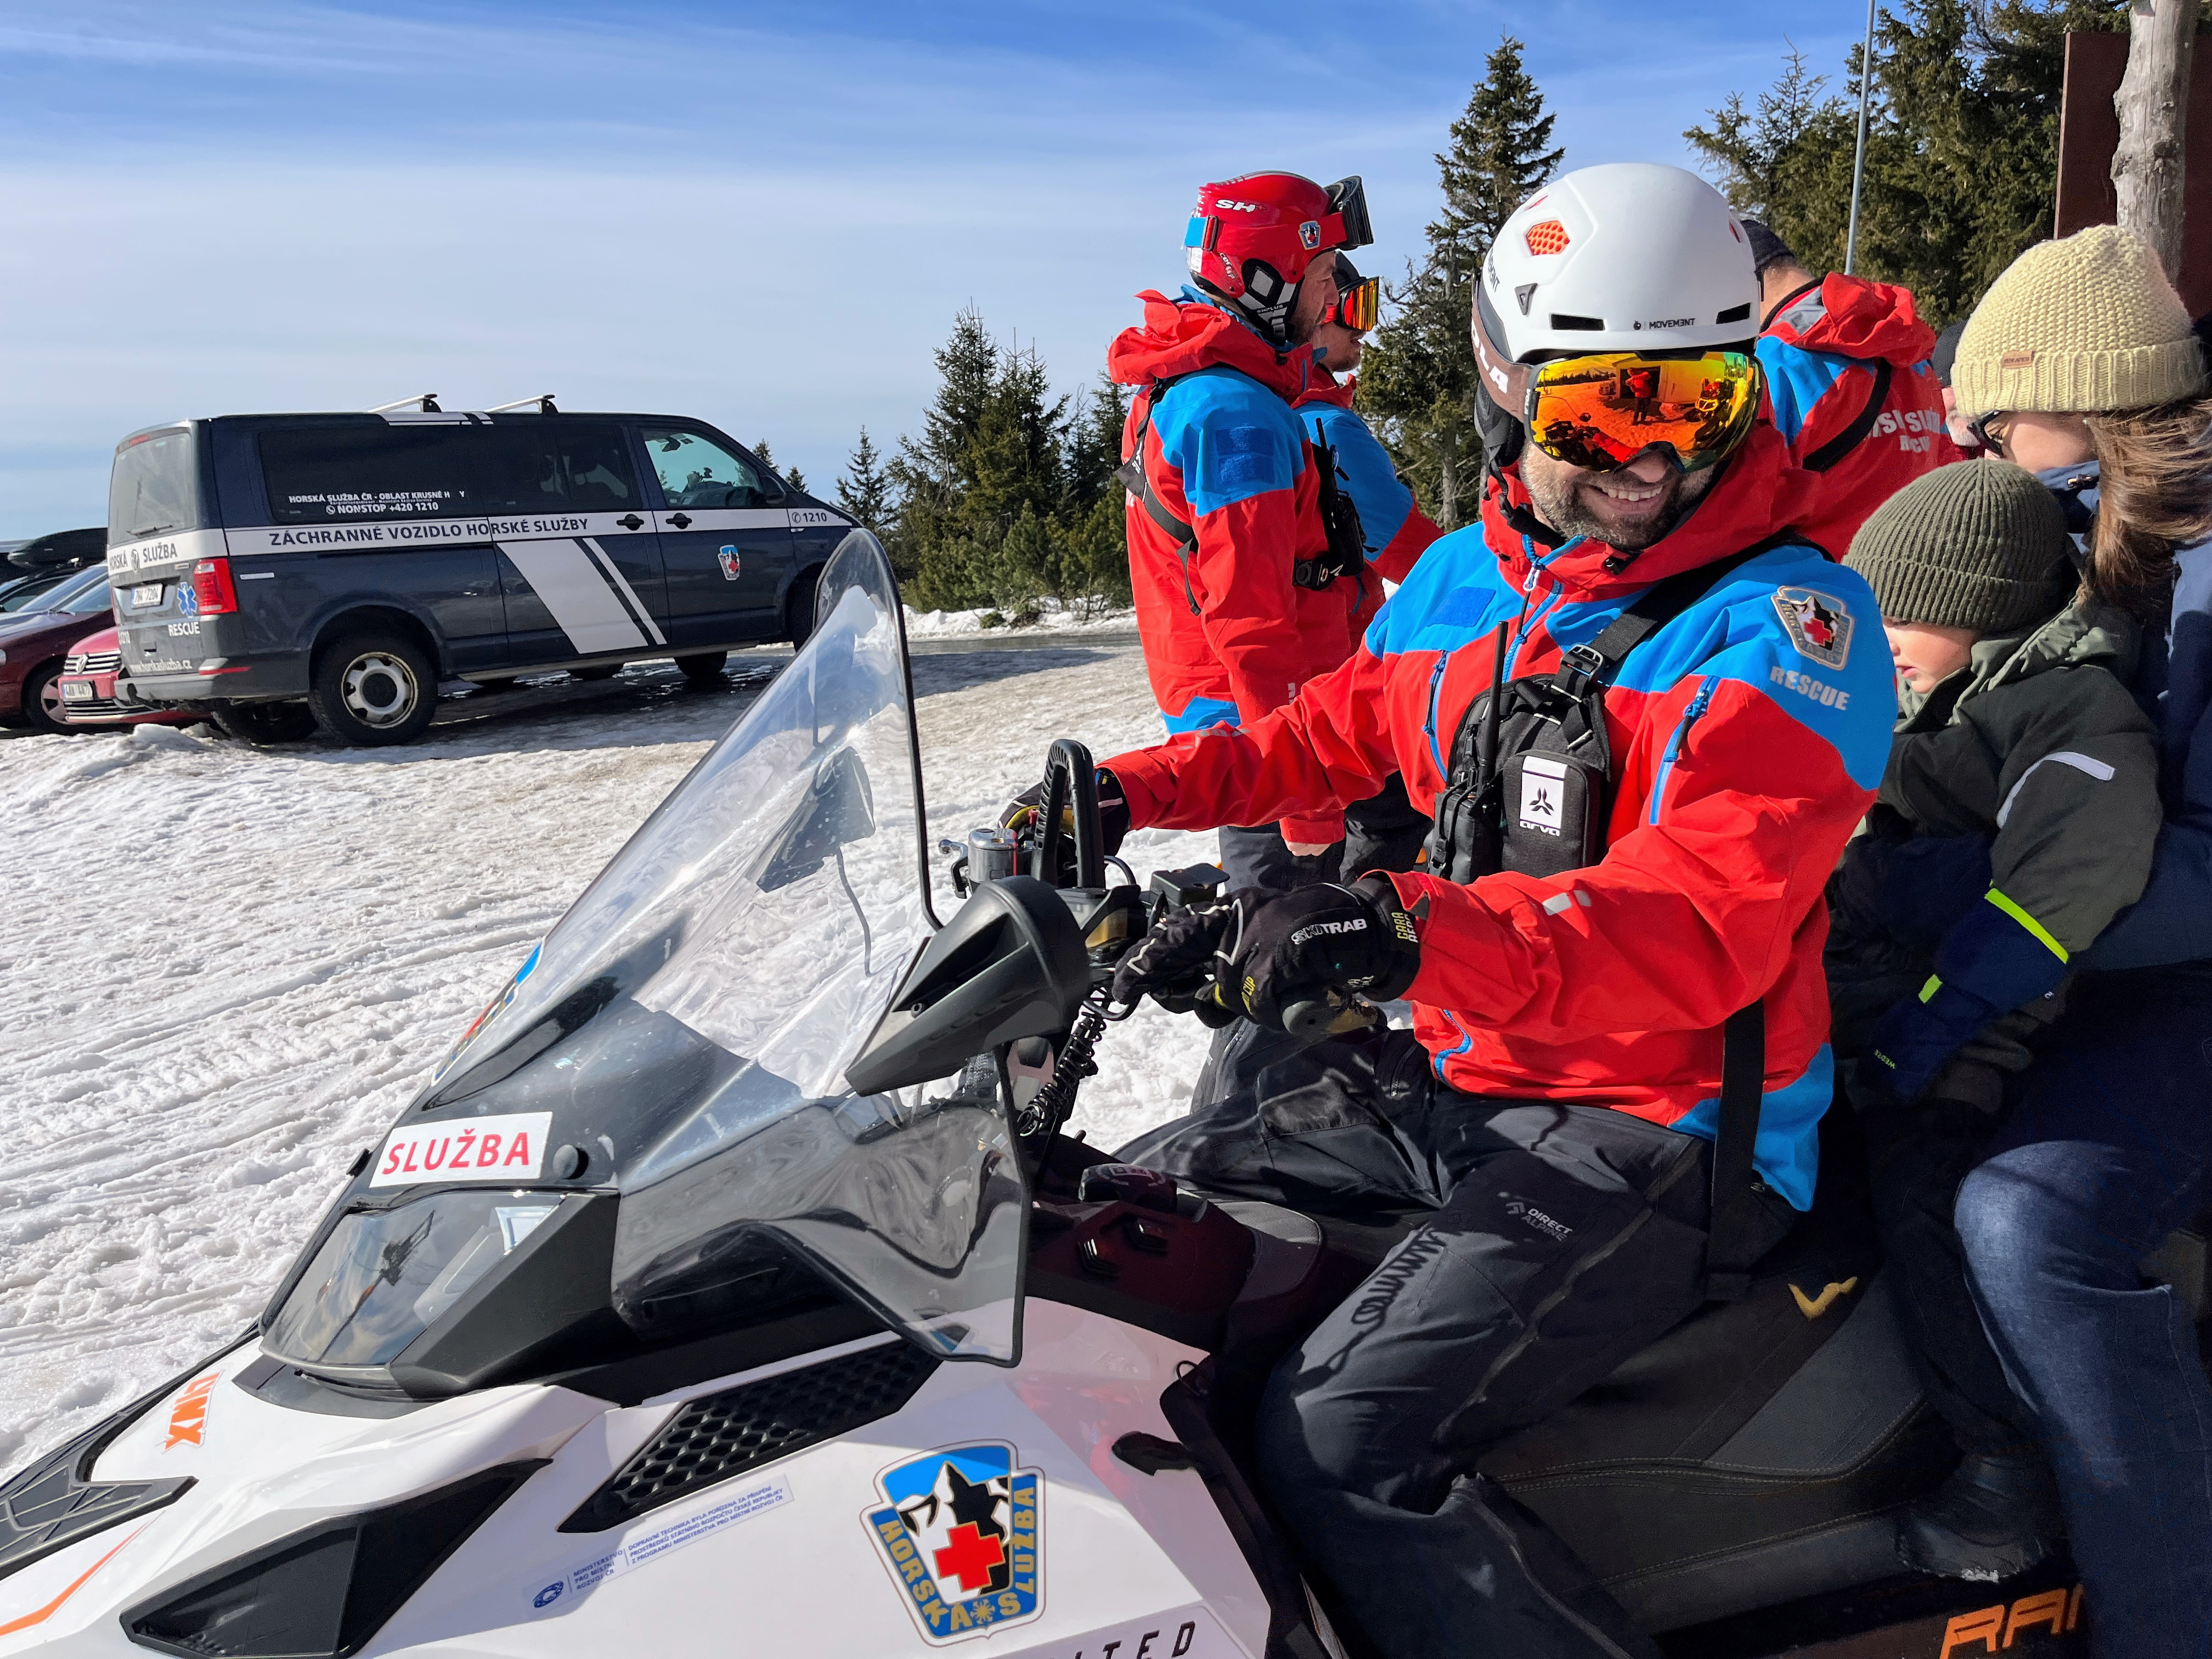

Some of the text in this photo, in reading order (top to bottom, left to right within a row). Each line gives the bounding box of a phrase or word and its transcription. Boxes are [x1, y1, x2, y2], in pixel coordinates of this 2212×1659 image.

[289, 494, 326, 503] HORSKÁ
[327, 493, 360, 501] SLUŽBA
[362, 492, 373, 500] ČR
[337, 503, 387, 514] NONSTOP
[389, 503, 413, 512] +420
[415, 501, 439, 511] 1210
[803, 512, 827, 523] 1210
[269, 517, 588, 546] ZÁCHRANNÉ VOZIDLO HORSKÉ SLUŽBY
[143, 542, 178, 563] SLUŽBA
[168, 621, 201, 637] RESCUE
[1769, 665, 1851, 712] RESCUE
[1519, 820, 1561, 837] arva
[382, 1128, 531, 1175] SLUŽBA
[1521, 1215, 1567, 1242] ALPINE
[1527, 1207, 1575, 1235] DIRECT
[628, 1531, 659, 1551] DOPRAVNÍ
[660, 1520, 690, 1536] TECHNIKA
[691, 1513, 707, 1523] BYLA
[636, 1542, 673, 1562] PROGRAMU
[673, 1523, 716, 1545] MINISTERSTVA
[716, 1517, 729, 1526] PRO
[751, 1498, 775, 1511] ROZVOJ
[573, 1550, 623, 1577] MINISTERSTVO
[574, 1573, 589, 1584] PRO
[577, 1573, 603, 1590] ROZVOJ
